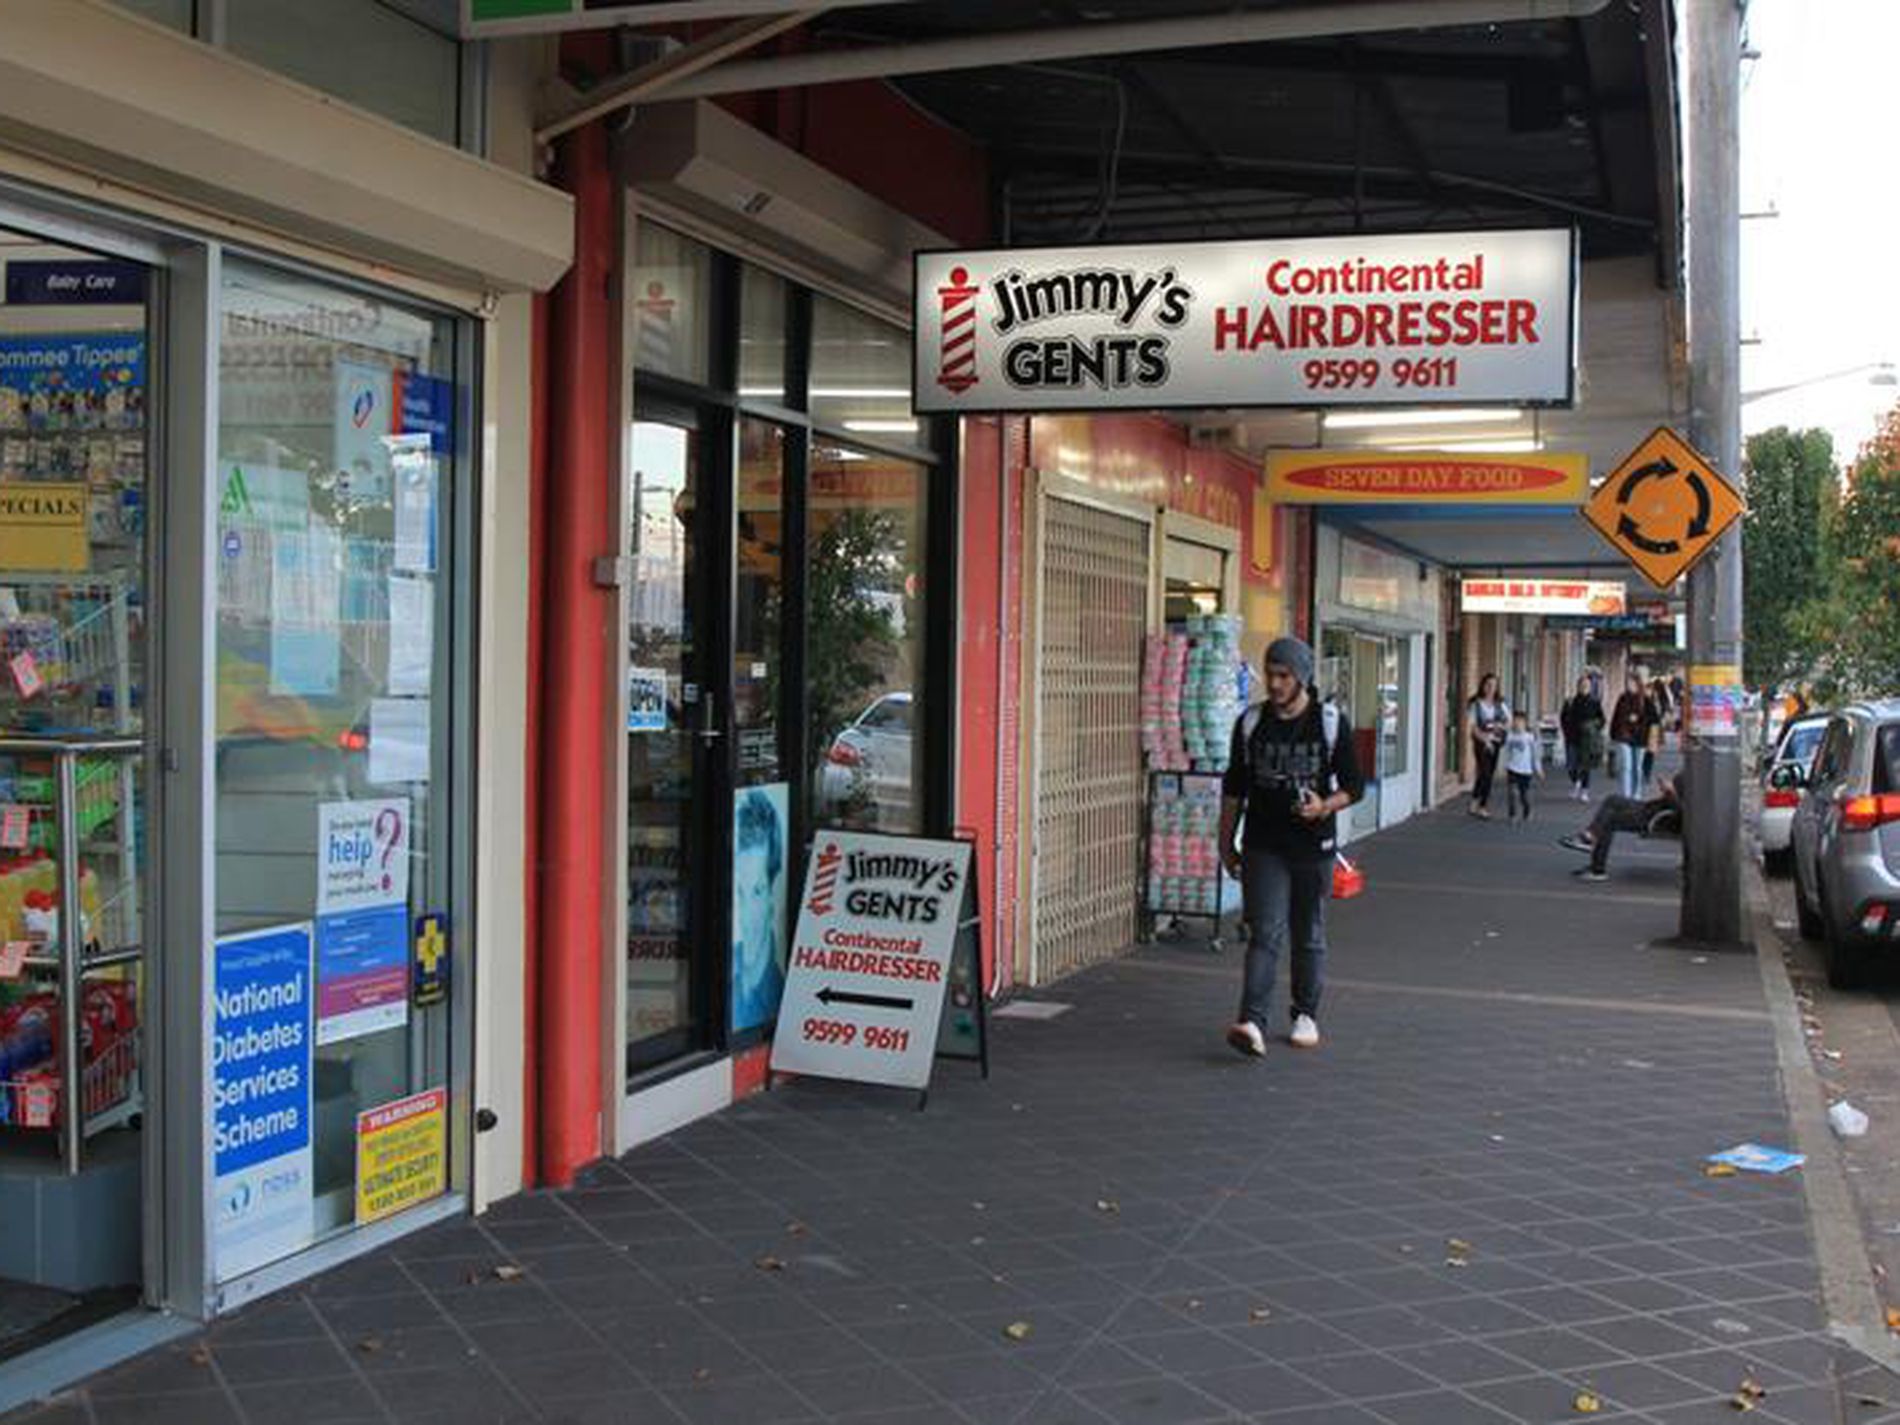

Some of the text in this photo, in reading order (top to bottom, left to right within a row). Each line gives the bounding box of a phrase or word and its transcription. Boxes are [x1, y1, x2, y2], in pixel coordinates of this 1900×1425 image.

[47, 274, 116, 291] Baby Care
[1266, 254, 1484, 296] Continental
[993, 267, 1194, 333] Jimmy's
[1214, 299, 1539, 351] HAIRDRESSER
[1004, 336, 1170, 389] GENTS
[1304, 357, 1458, 389] 9599 9611
[1325, 467, 1522, 488] SEVEN DAY FOOD
[328, 834, 373, 868] help
[845, 852, 959, 892] Jimmy's
[845, 889, 939, 922] GENTS
[823, 928, 922, 954] Continental
[794, 946, 942, 983] HAIRDRESSER
[803, 1017, 909, 1050] 9599 9611
[213, 1062, 299, 1109] Services
[214, 1105, 298, 1152] Scheme
